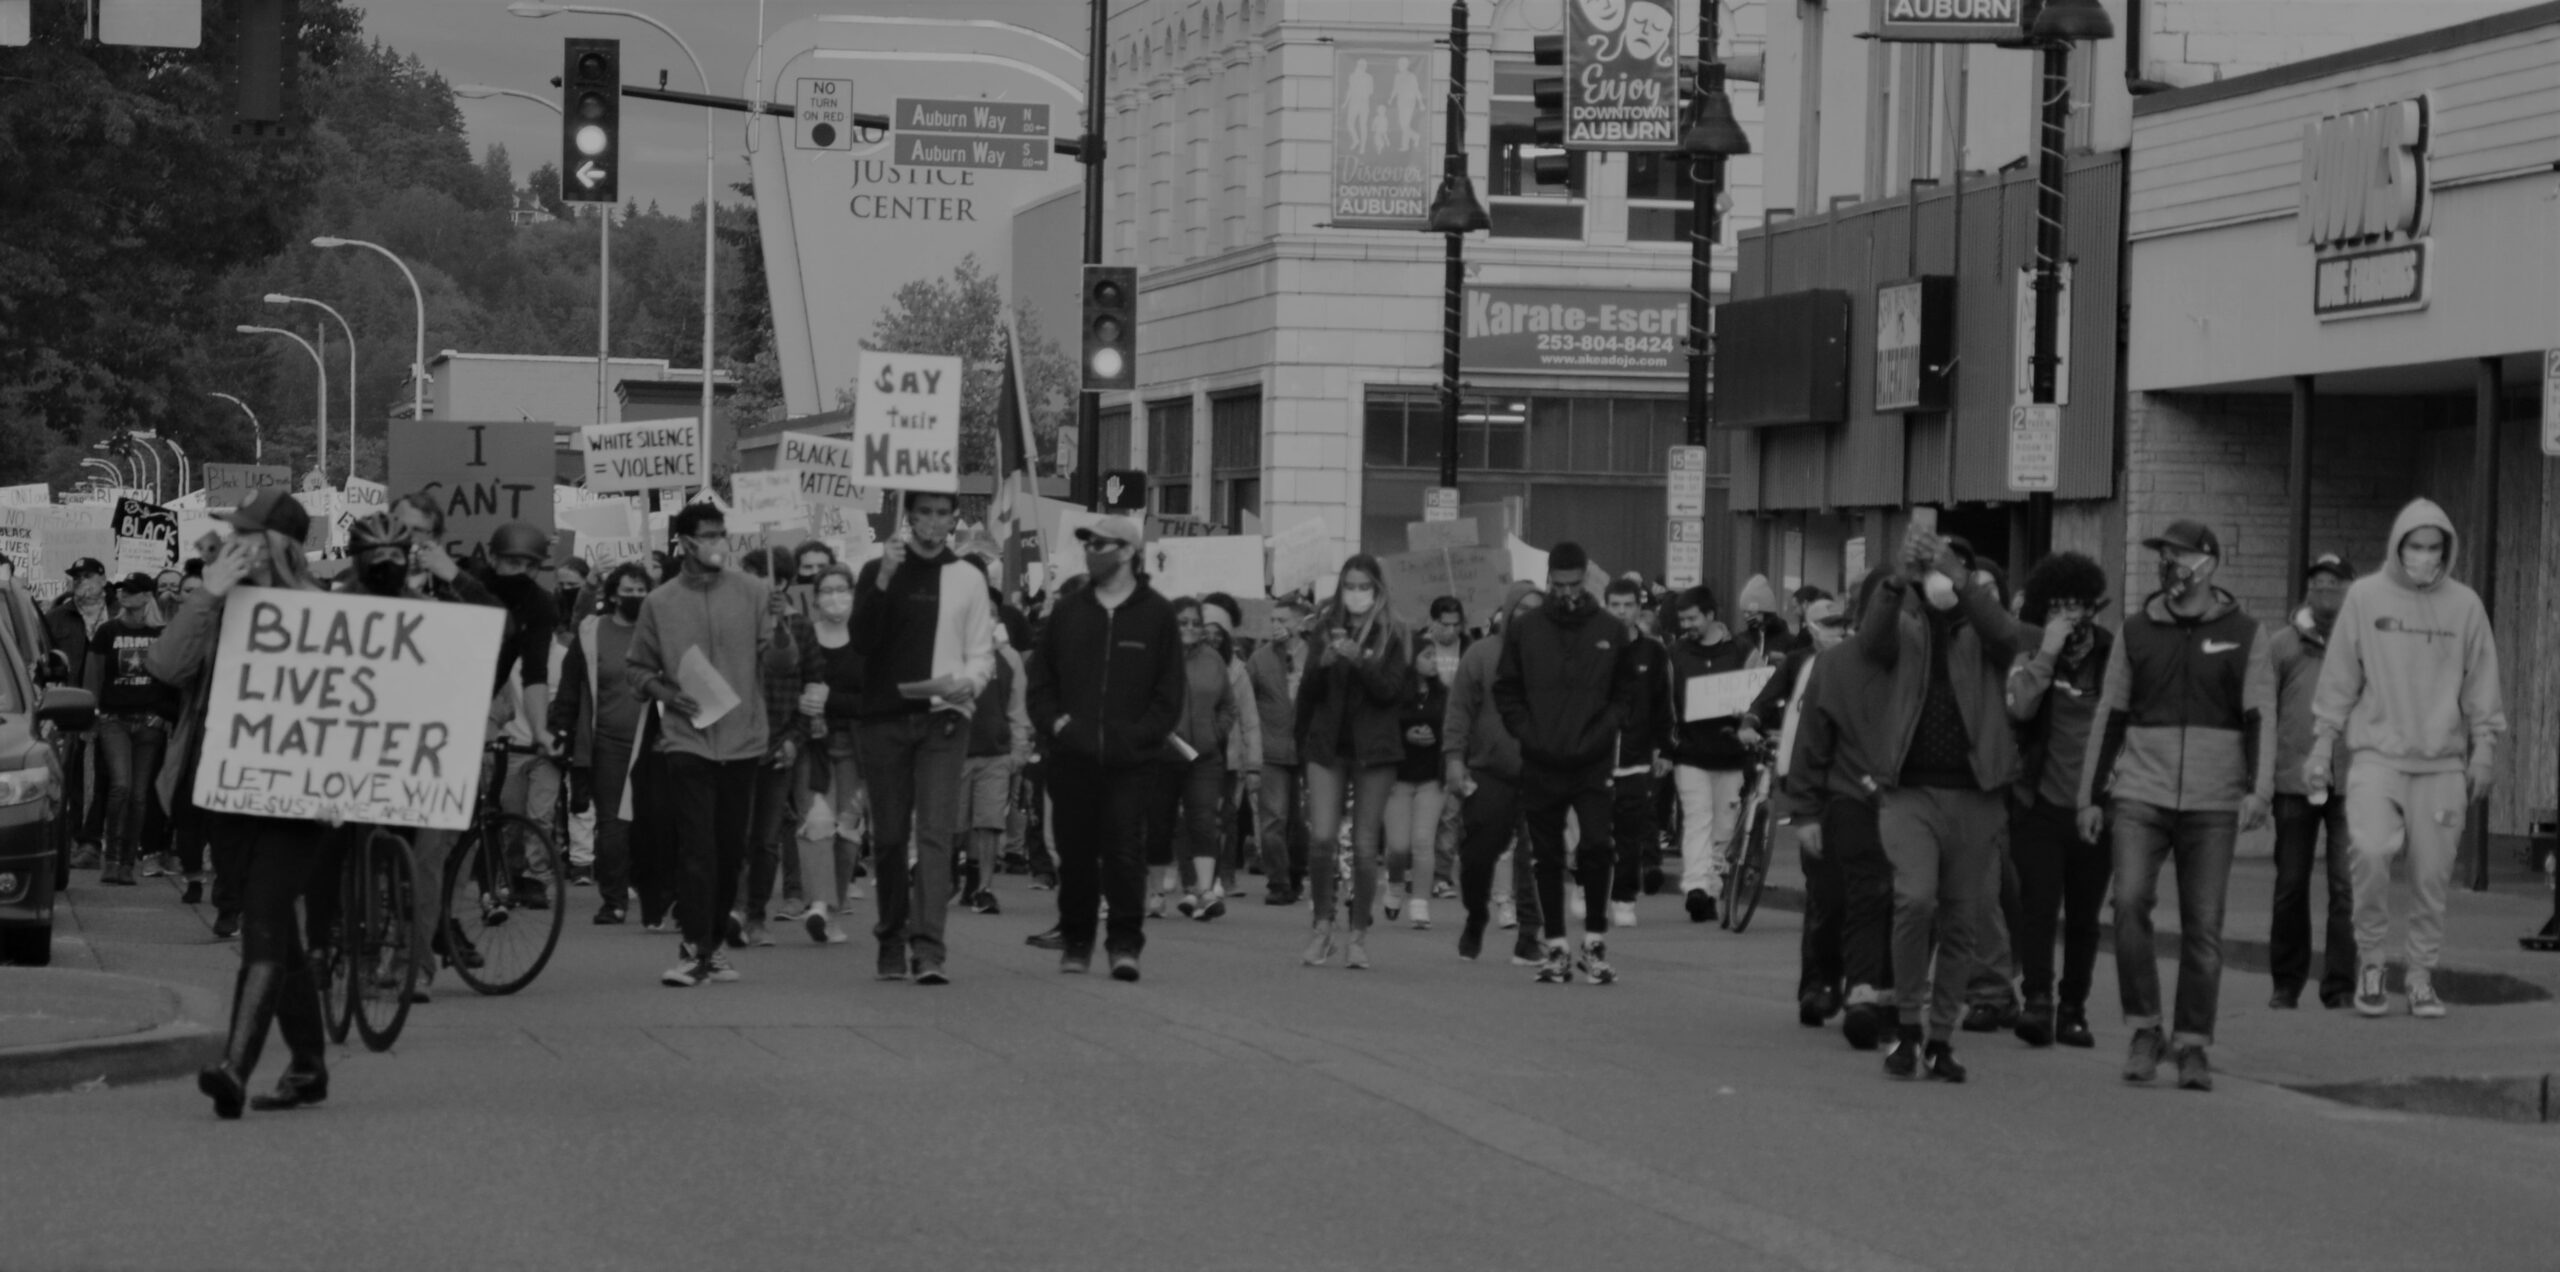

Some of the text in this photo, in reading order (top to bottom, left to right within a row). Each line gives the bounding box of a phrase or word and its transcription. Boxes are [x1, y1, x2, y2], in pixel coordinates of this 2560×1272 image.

[1893, 0, 2011, 18] AUBURN
[813, 81, 836, 95] NO
[1581, 63, 1661, 110] Enjoy
[811, 97, 838, 108] TURN
[1573, 106, 1670, 119] DOWNTOWN
[803, 110, 845, 122] ON RED
[912, 104, 1032, 133] Auburn Way N
[1572, 121, 1671, 139] AUBURN
[911, 139, 1031, 167] Auburn Way S
[1340, 186, 1422, 198] DOWNTOWN
[850, 194, 977, 221] CENTER
[1340, 199, 1423, 215] AUBURN
[1537, 334, 1674, 353] 253-804-8424
[875, 364, 942, 394] SAY
[2014, 408, 2025, 430] 2
[465, 425, 487, 467] I
[588, 428, 694, 451] WHITE SILENCE
[786, 440, 836, 467] BLACK
[613, 454, 696, 478] VIOLENCE
[122, 516, 177, 545] BLACK
[0, 540, 30, 553] IVES
[246, 601, 425, 664] BLACK
[238, 663, 377, 716] LIVES
[230, 713, 448, 777] MATTER
[217, 758, 468, 815] LET LOVE WIN
[205, 791, 228, 808] IN
